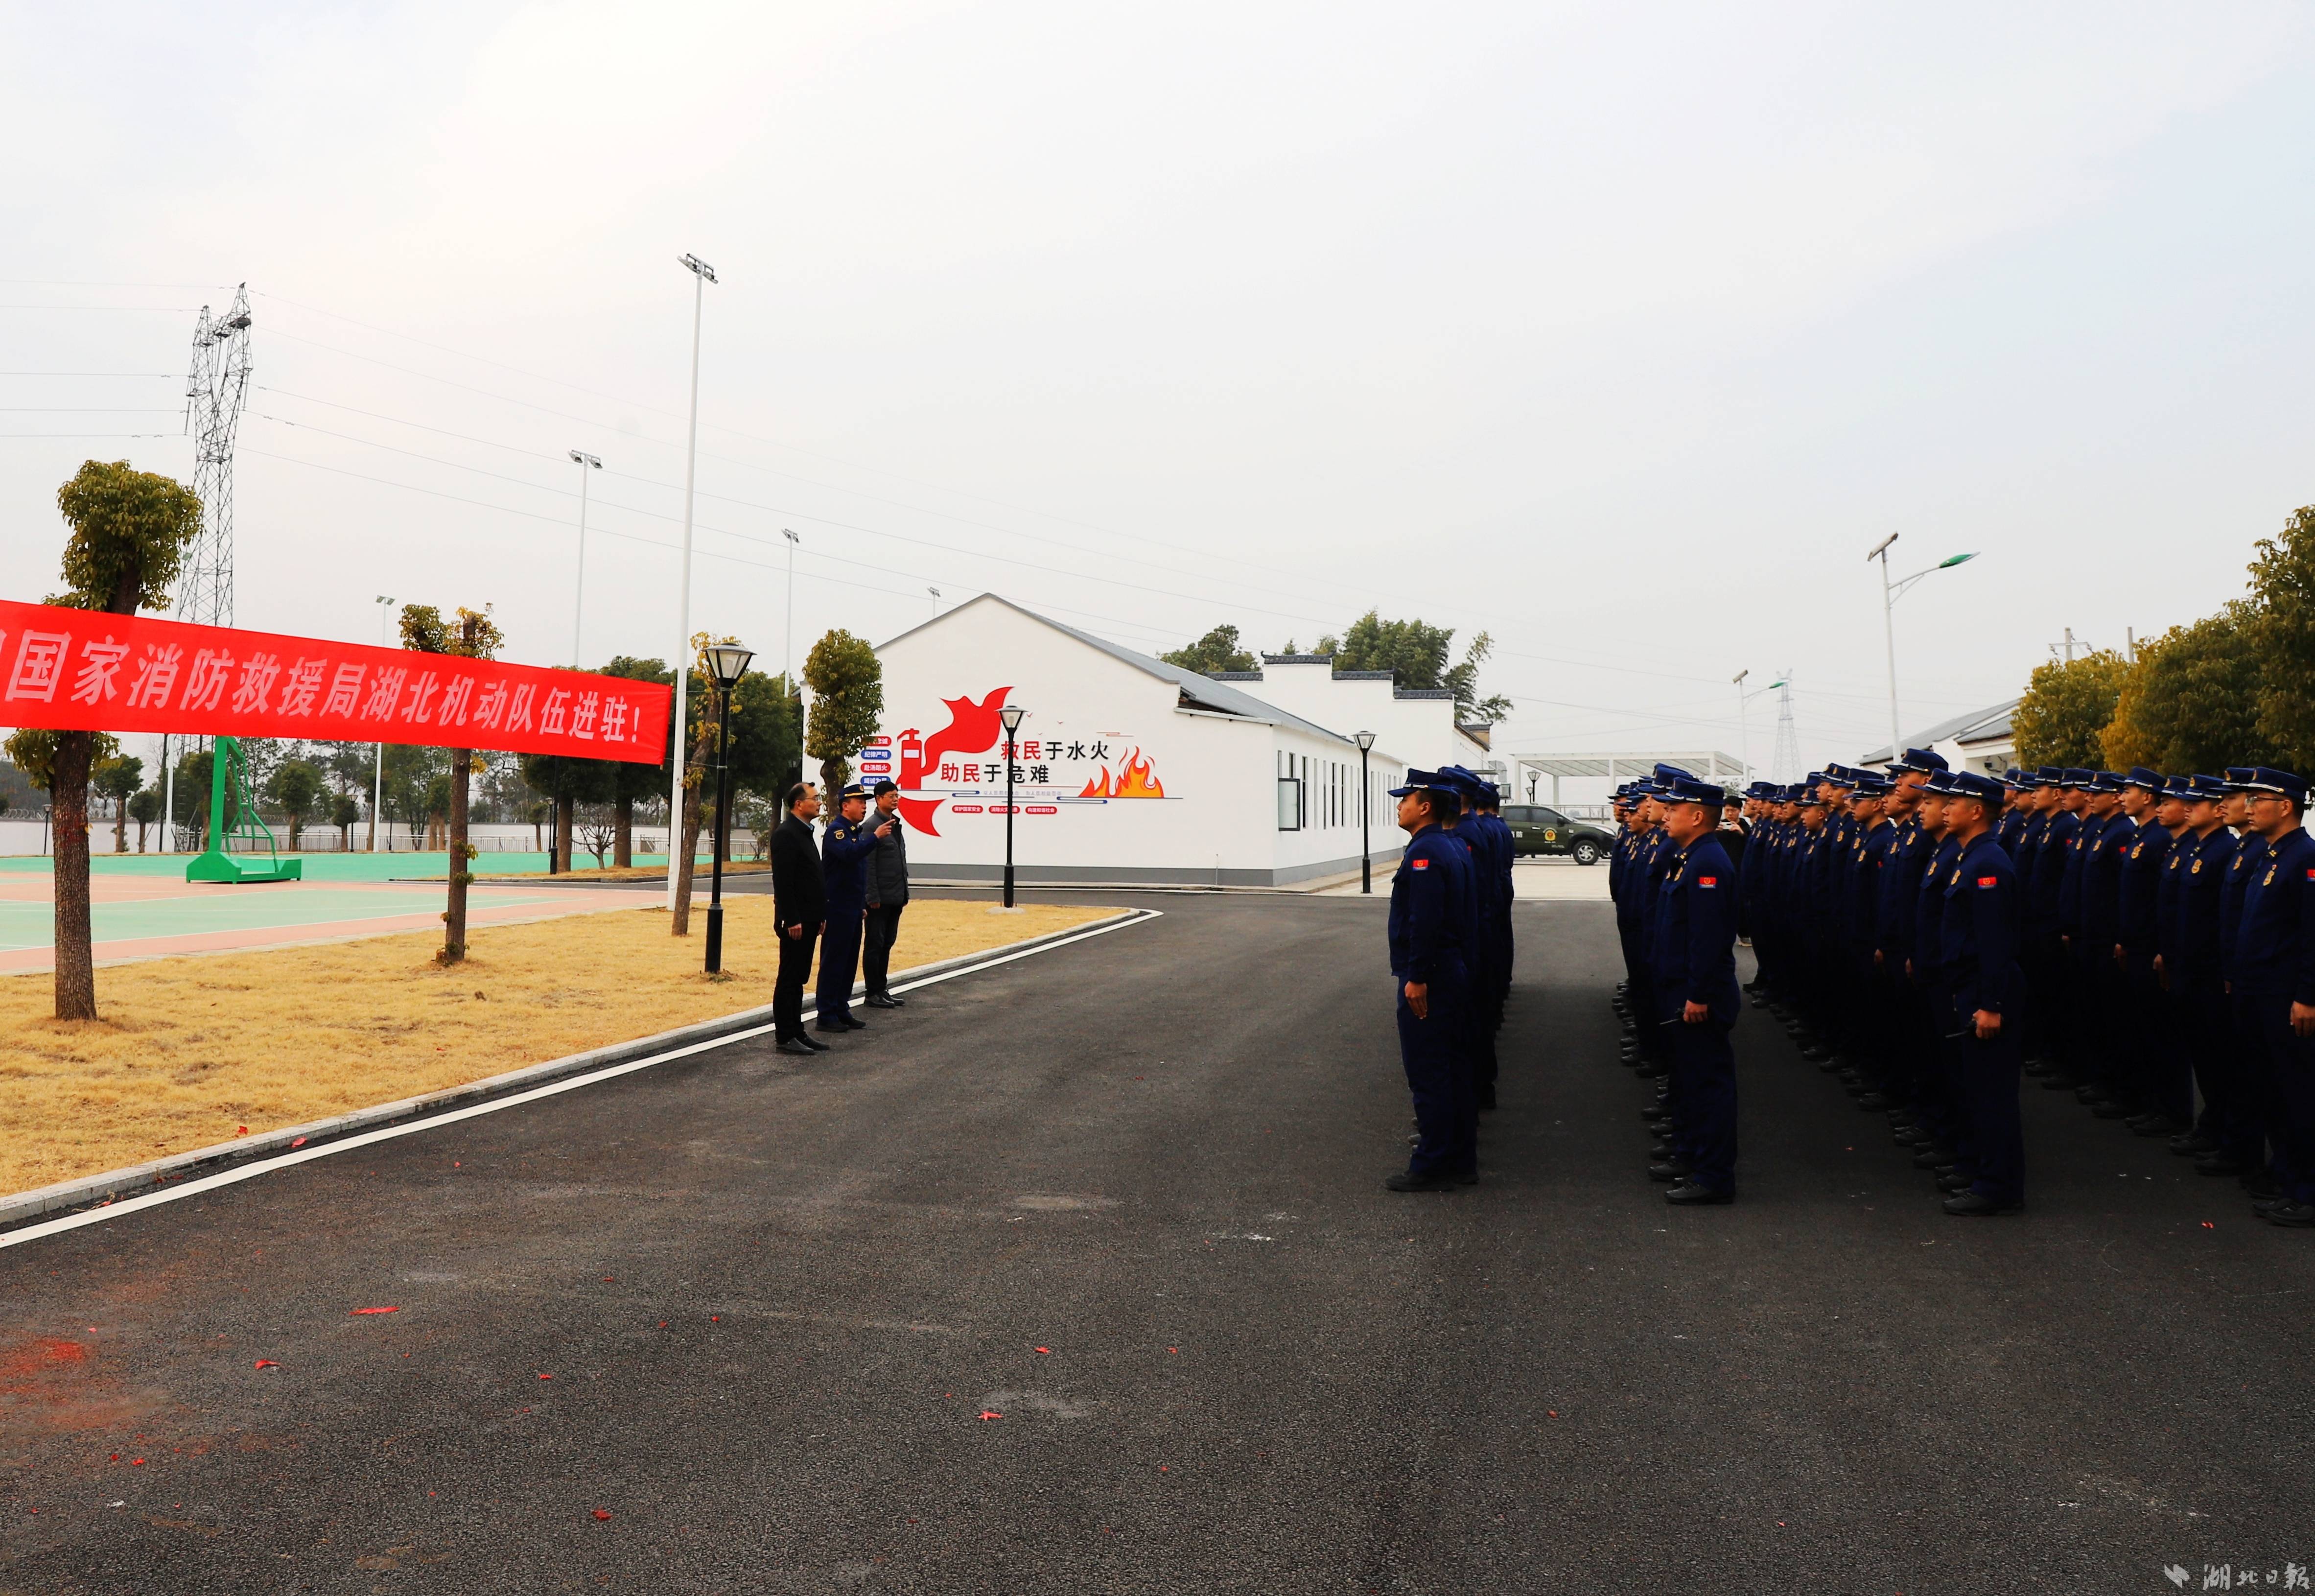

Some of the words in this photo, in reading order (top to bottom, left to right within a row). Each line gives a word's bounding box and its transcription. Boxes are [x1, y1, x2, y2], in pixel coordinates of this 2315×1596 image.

[0, 629, 640, 743] 国家消防救援局湖北机动队伍进驻！
[1001, 740, 1109, 760] 救民于水火
[940, 763, 1049, 784] 助民于危难
